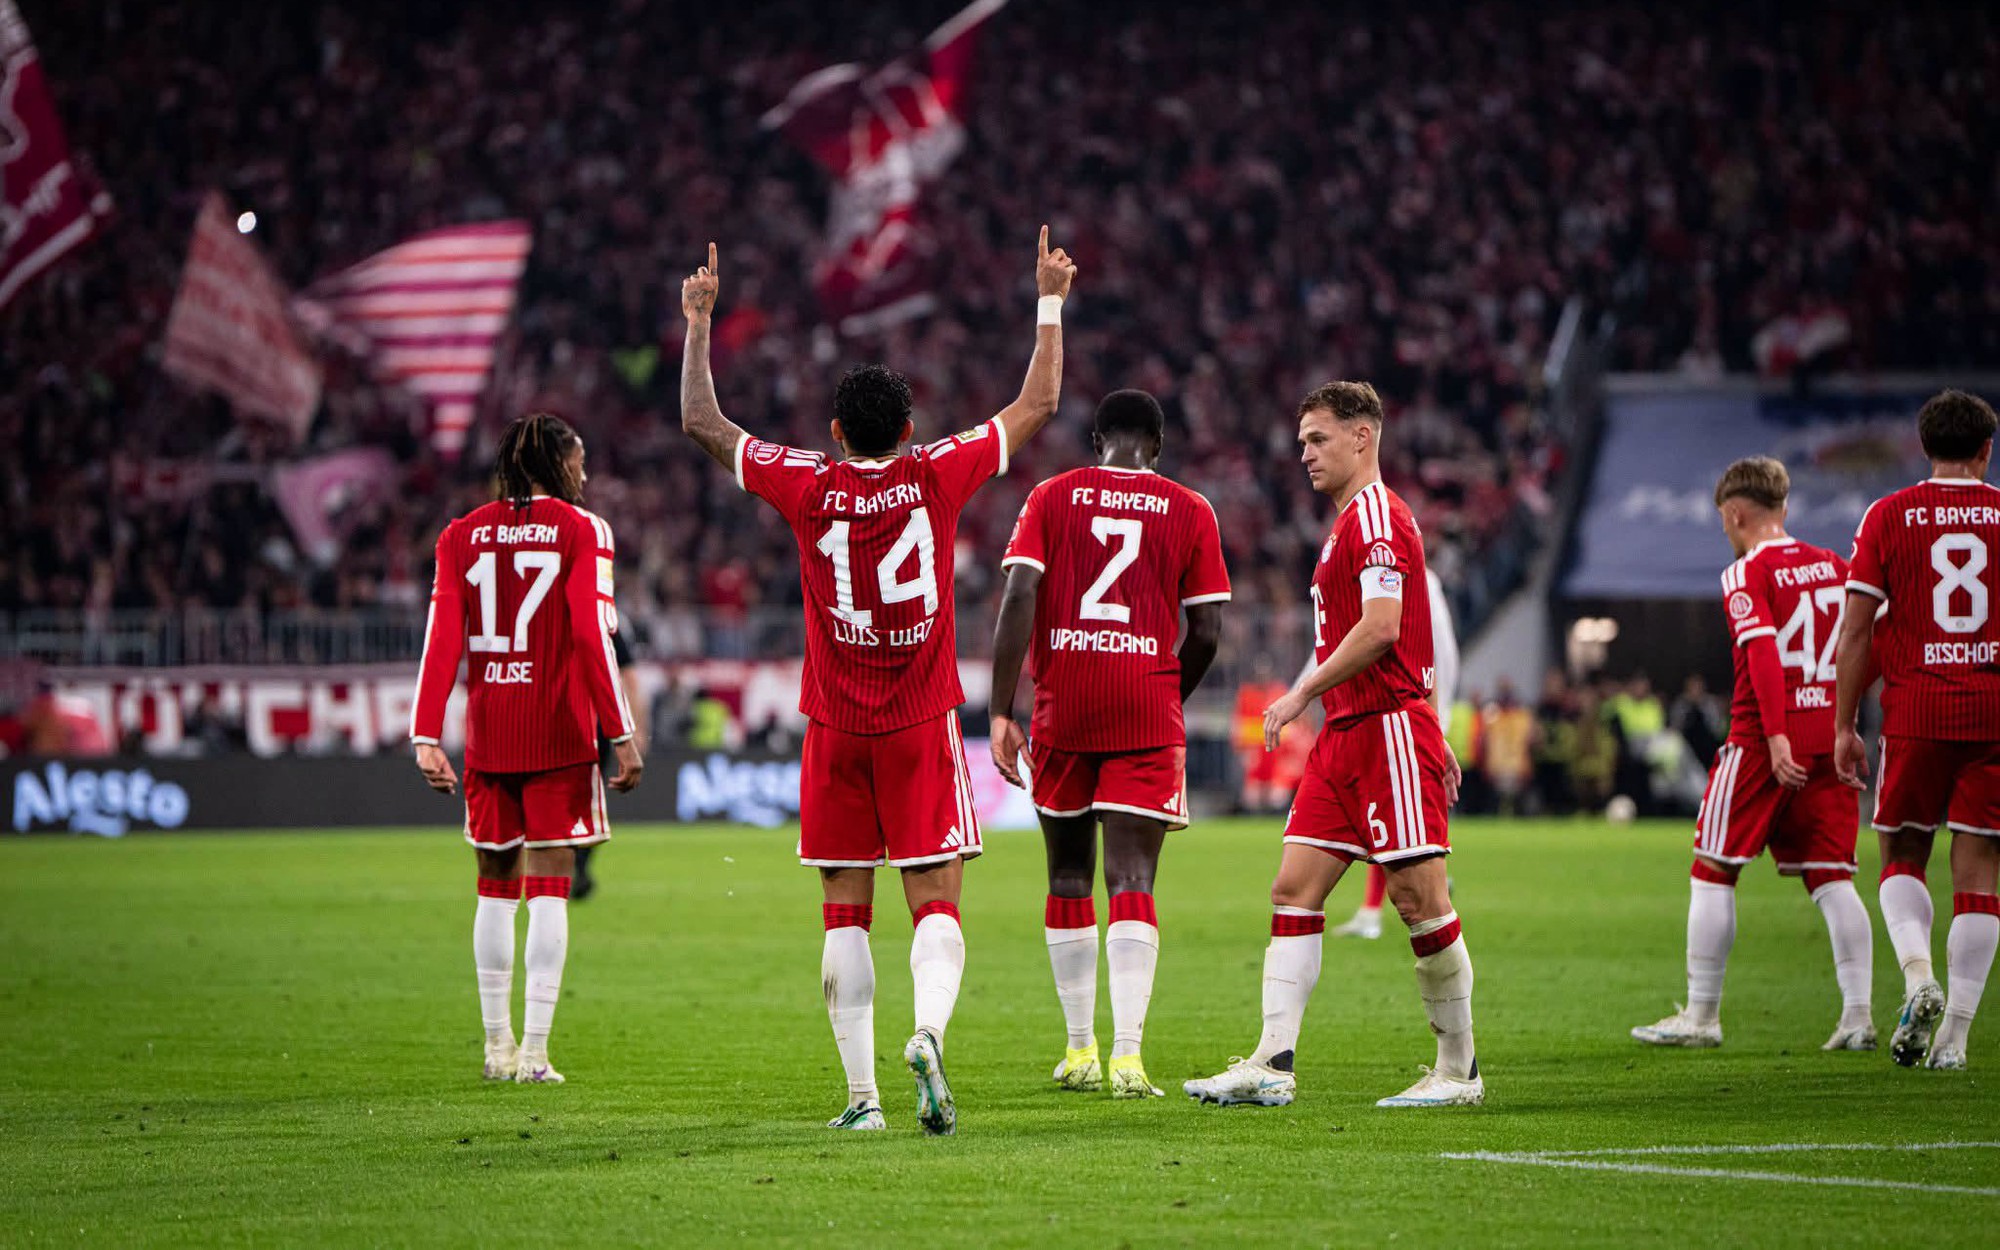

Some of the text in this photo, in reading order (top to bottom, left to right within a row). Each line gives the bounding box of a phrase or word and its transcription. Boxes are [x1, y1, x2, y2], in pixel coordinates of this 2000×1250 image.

[823, 482, 922, 514] FC BAYERN
[1072, 488, 1169, 515] FC BAYERN
[1905, 506, 1928, 527] FC
[471, 524, 558, 544] FC BAYERN
[816, 507, 938, 626] 14
[1080, 516, 1143, 624] 2
[1774, 568, 1794, 588] FC
[1931, 533, 1988, 633] 8
[465, 551, 562, 653] 17
[1051, 628, 1158, 656] UPAMECANO
[1776, 586, 1847, 684] 42
[1924, 642, 1999, 665] BISCHOF
[484, 661, 533, 683] OLISE
[1795, 686, 1832, 708] KARL
[1367, 802, 1389, 848] 6
